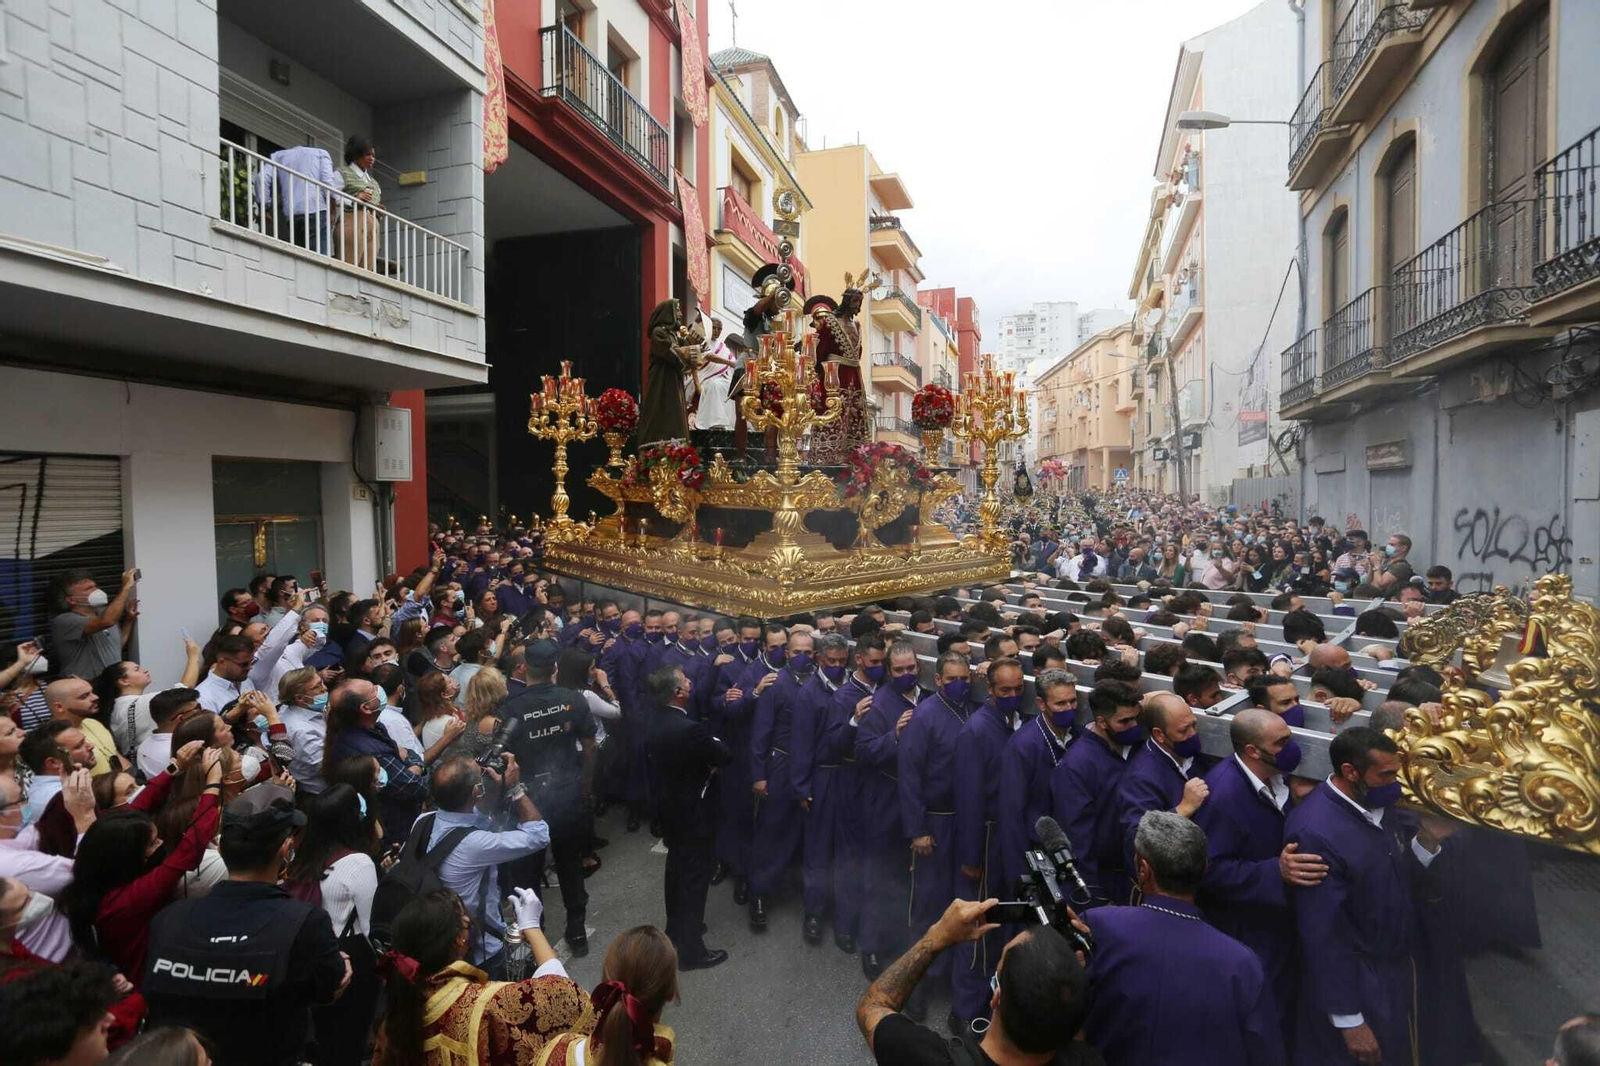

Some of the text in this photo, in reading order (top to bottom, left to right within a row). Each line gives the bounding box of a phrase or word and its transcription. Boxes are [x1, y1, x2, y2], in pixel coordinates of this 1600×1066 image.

[524, 704, 566, 721] POLICIA
[529, 725, 563, 739] U.I.P.
[153, 958, 251, 983] POLICIA
